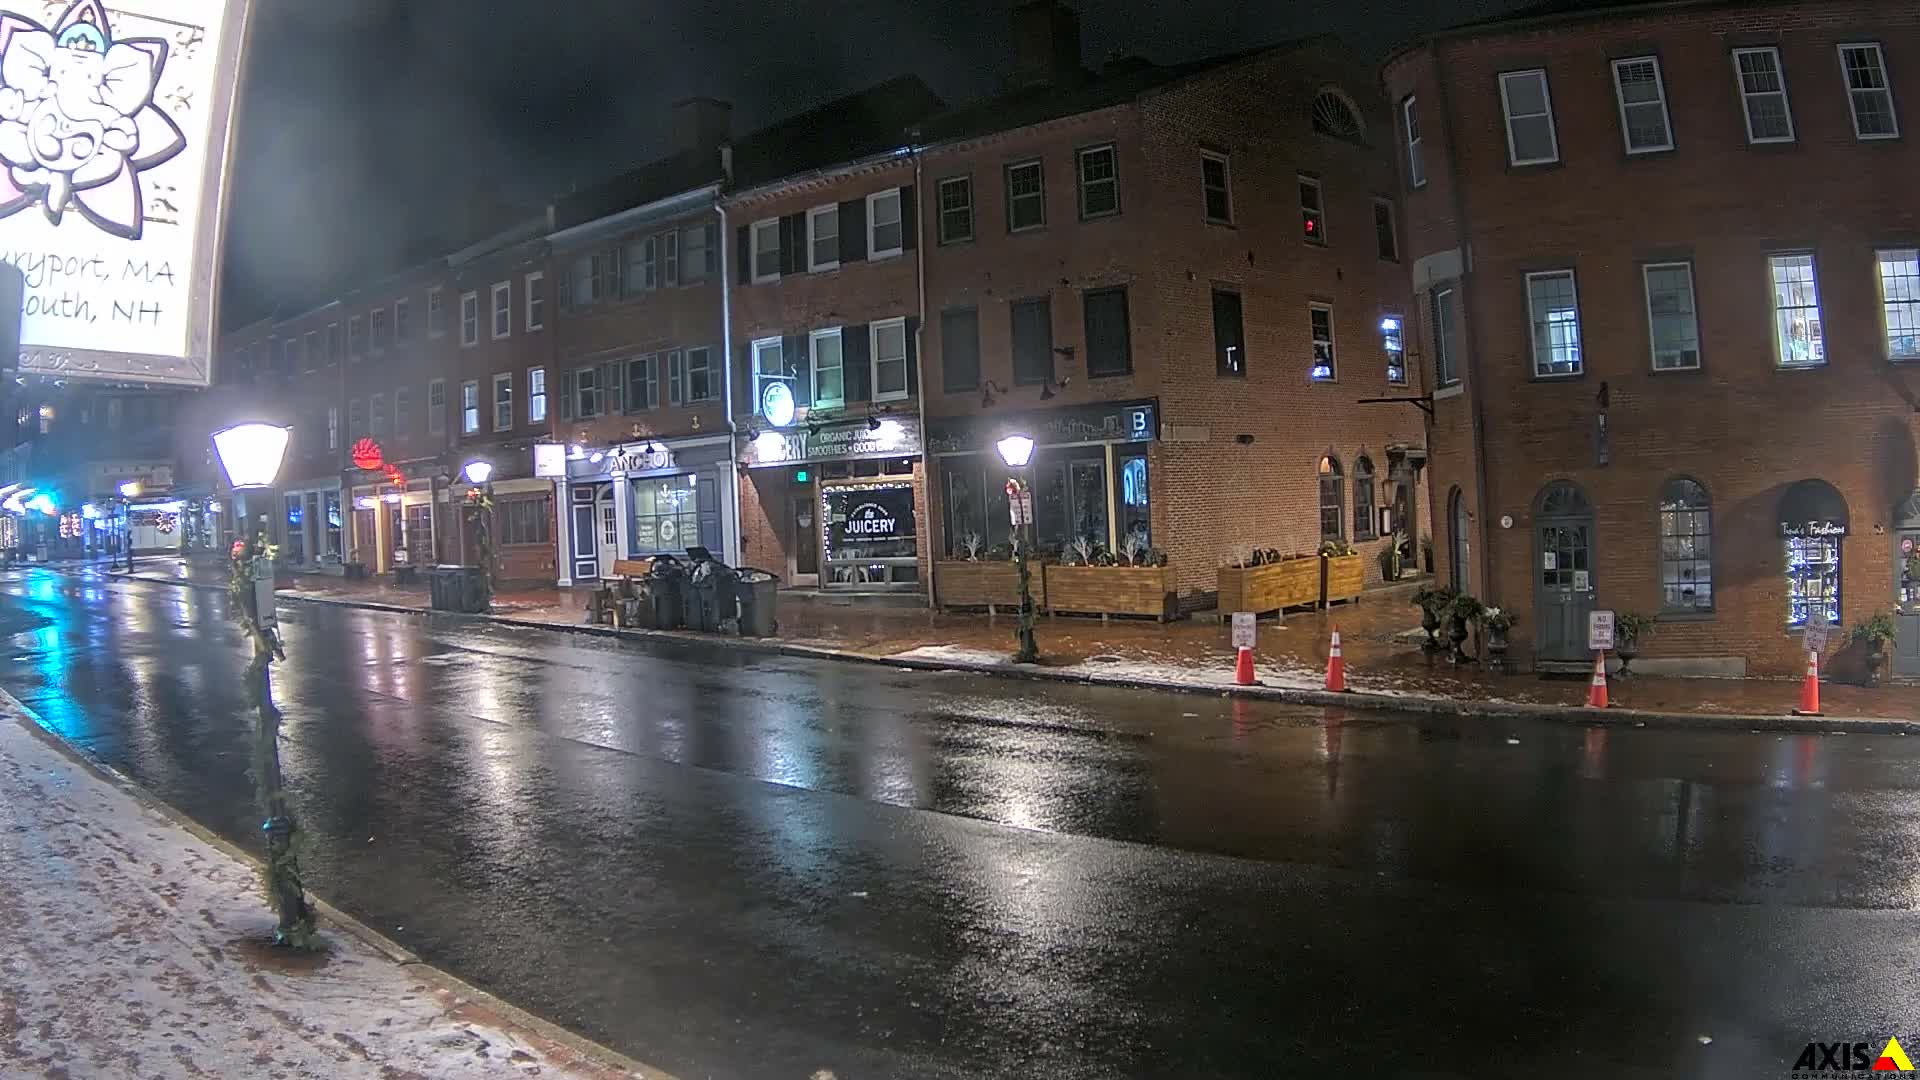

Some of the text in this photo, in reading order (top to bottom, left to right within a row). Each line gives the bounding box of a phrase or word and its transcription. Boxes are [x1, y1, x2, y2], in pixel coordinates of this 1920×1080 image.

[122, 259, 175, 286] MA
[112, 300, 163, 326] NH
[1133, 412, 1146, 430] B
[820, 431, 852, 443] ORGANIC
[808, 444, 848, 456] SMOOTHIES
[844, 518, 896, 534] JUICERY
